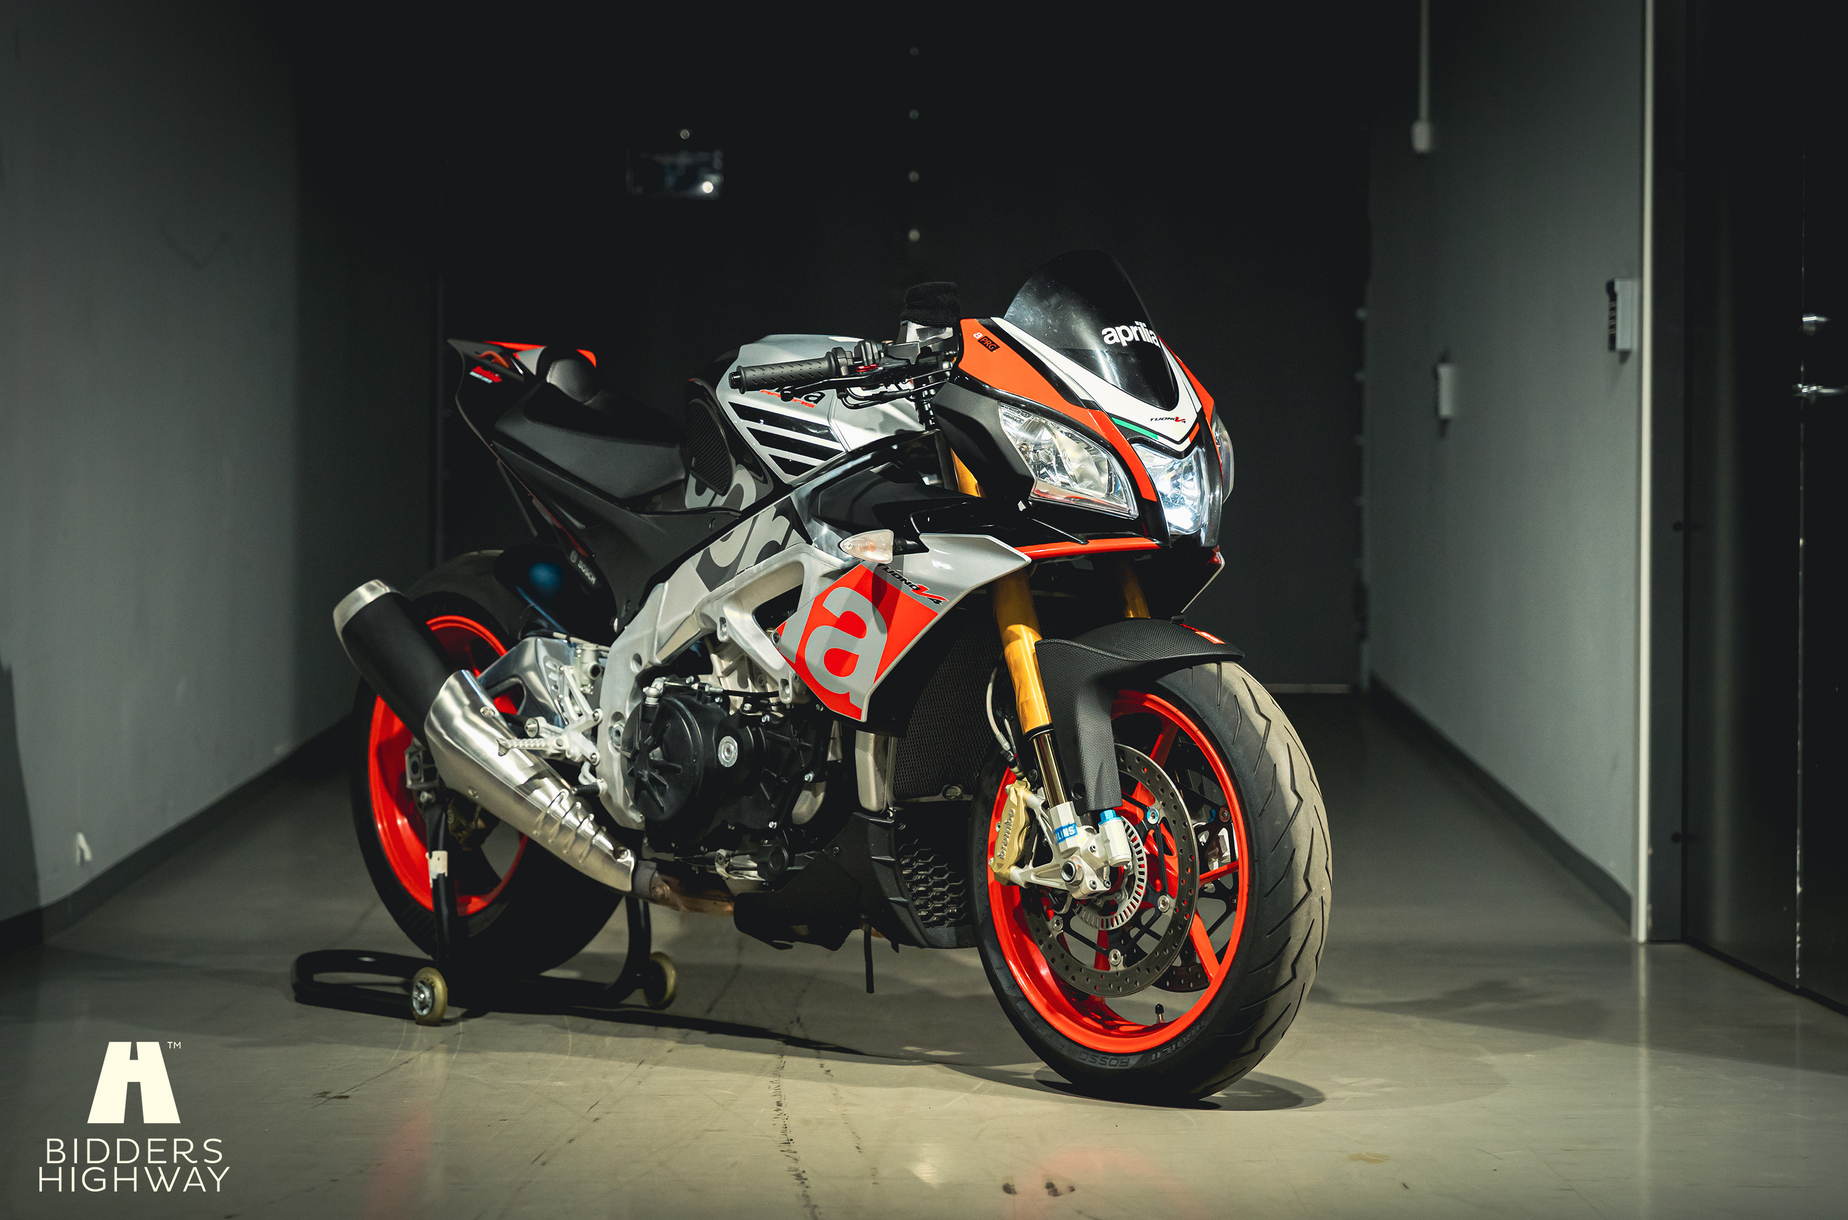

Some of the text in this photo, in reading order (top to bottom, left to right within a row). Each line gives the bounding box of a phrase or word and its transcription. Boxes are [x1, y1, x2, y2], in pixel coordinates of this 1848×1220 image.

[1101, 320, 1161, 348] aprilia
[577, 560, 597, 585] BOSCH
[997, 808, 1016, 860] brembo
[1078, 1051, 1131, 1068] ROSSO
